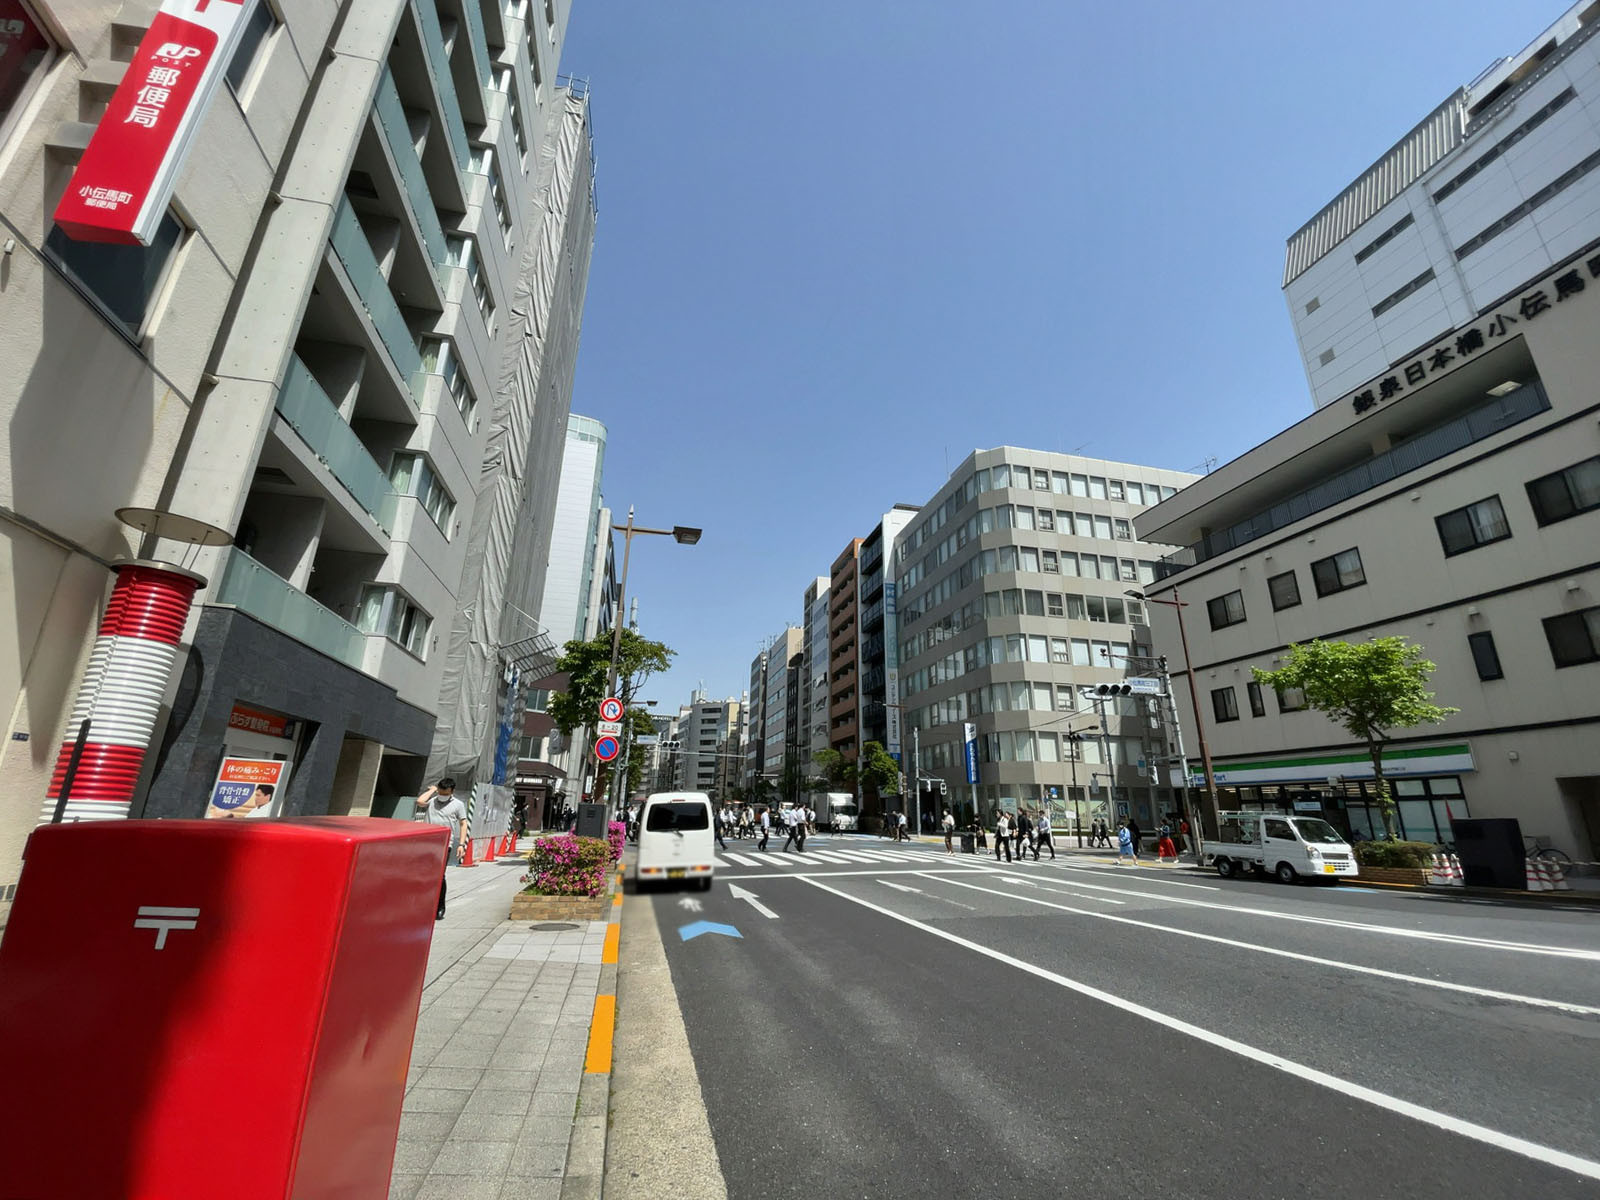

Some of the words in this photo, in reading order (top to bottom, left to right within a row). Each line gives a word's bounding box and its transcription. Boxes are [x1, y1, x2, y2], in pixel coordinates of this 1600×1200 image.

[150, 55, 192, 68] POST
[123, 65, 182, 128] 郵便局
[78, 184, 133, 205] 小伝馬町
[84, 197, 118, 211] 郵便局
